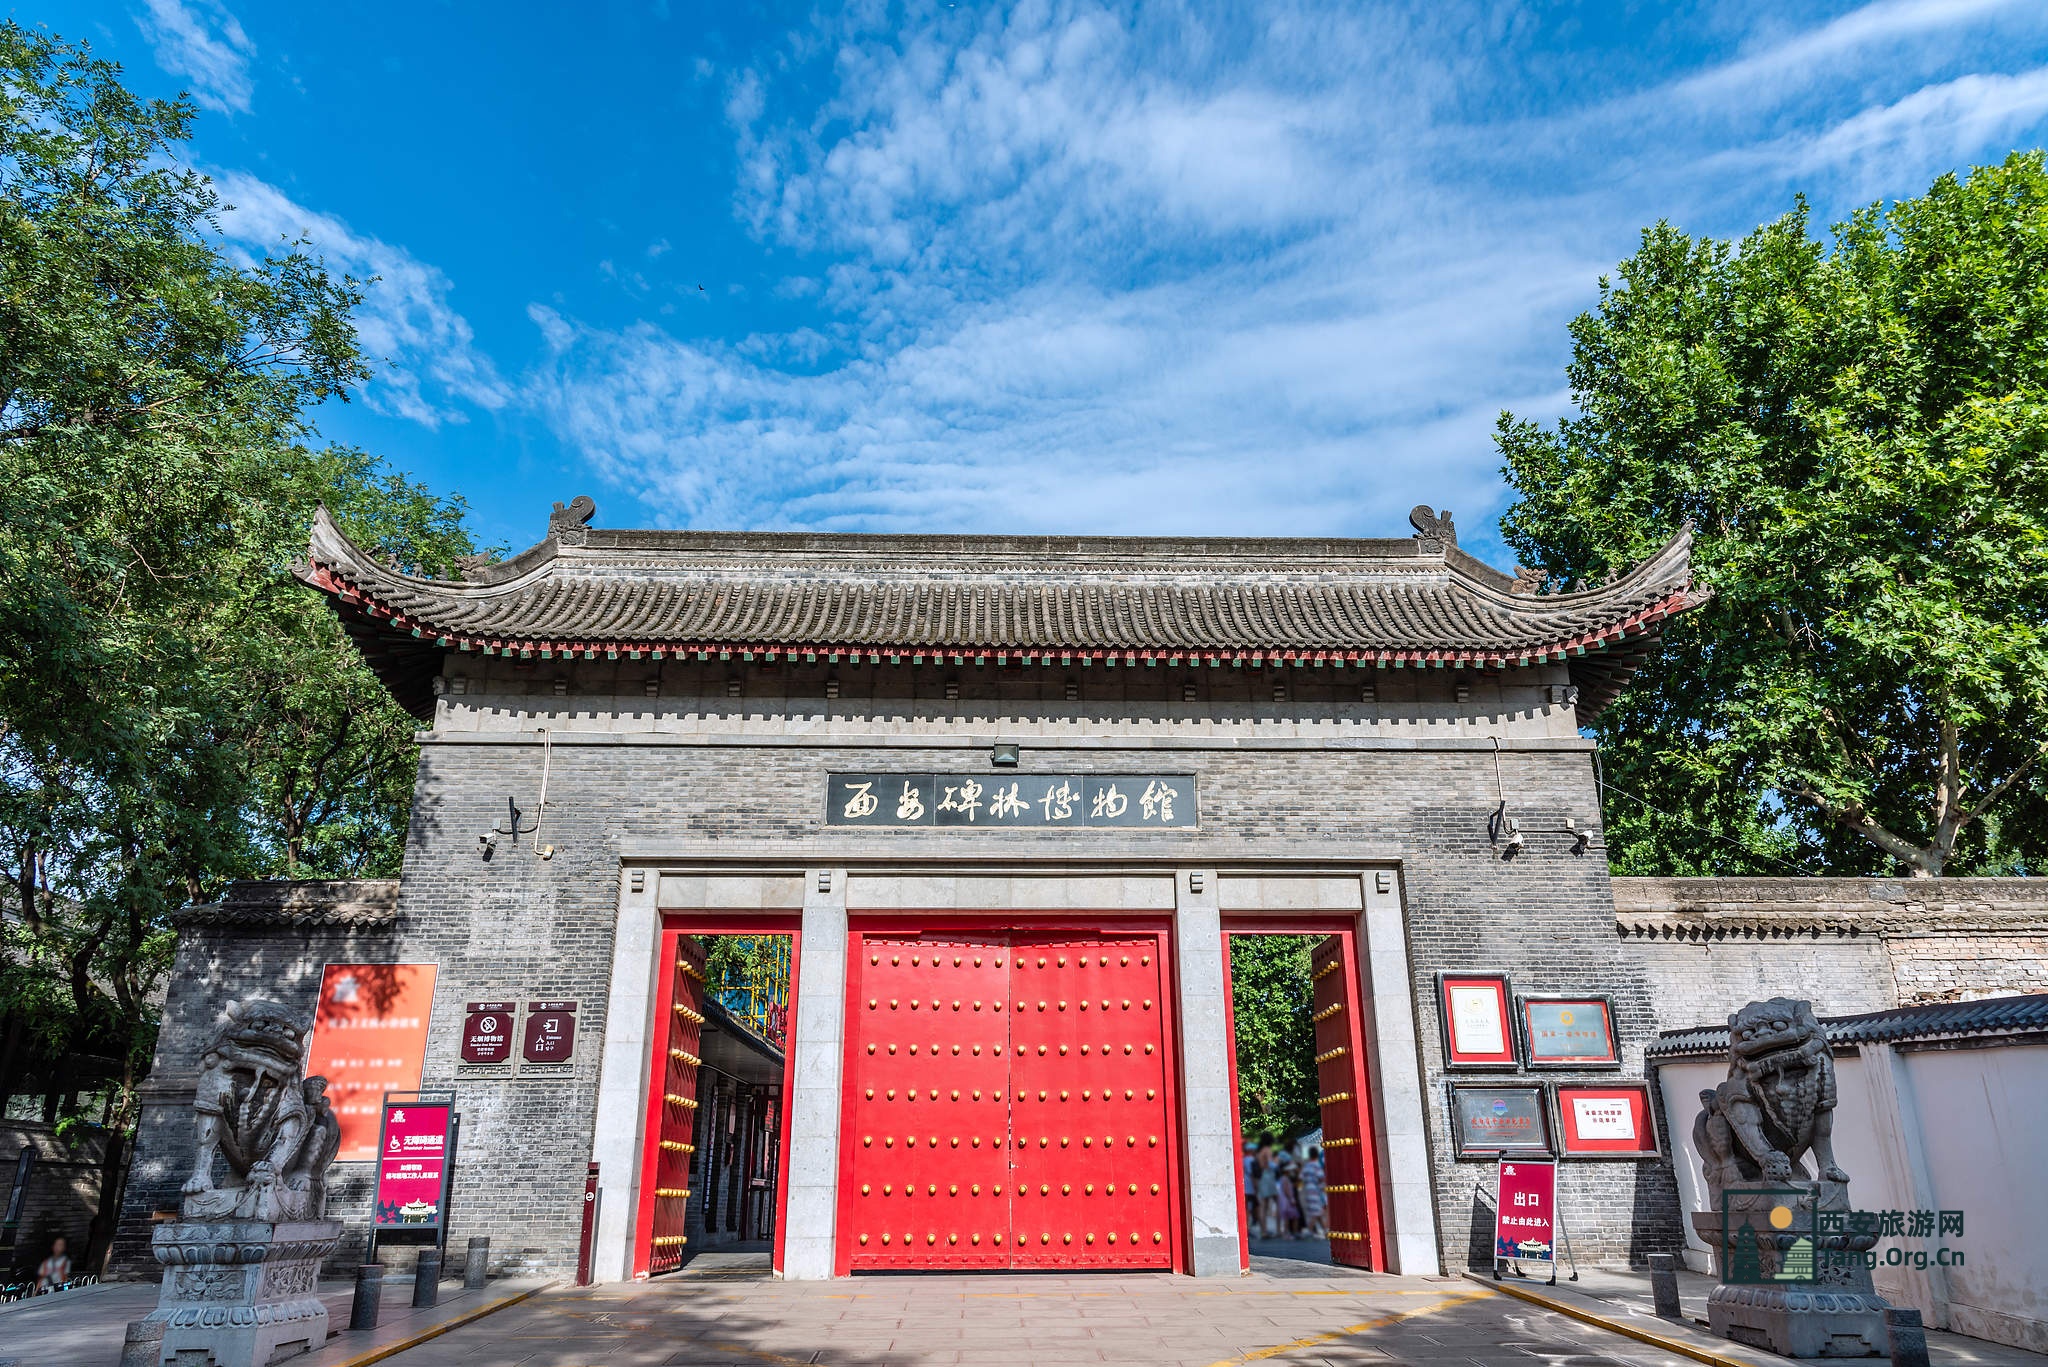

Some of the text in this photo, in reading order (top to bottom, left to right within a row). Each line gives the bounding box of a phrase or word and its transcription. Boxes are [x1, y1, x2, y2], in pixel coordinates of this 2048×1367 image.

[535, 1034, 545, 1051] 入口
[403, 1134, 444, 1145] 无障碍通道
[1513, 1191, 1539, 1207] 出口
[1501, 1215, 1550, 1228] 禁止由此进入
